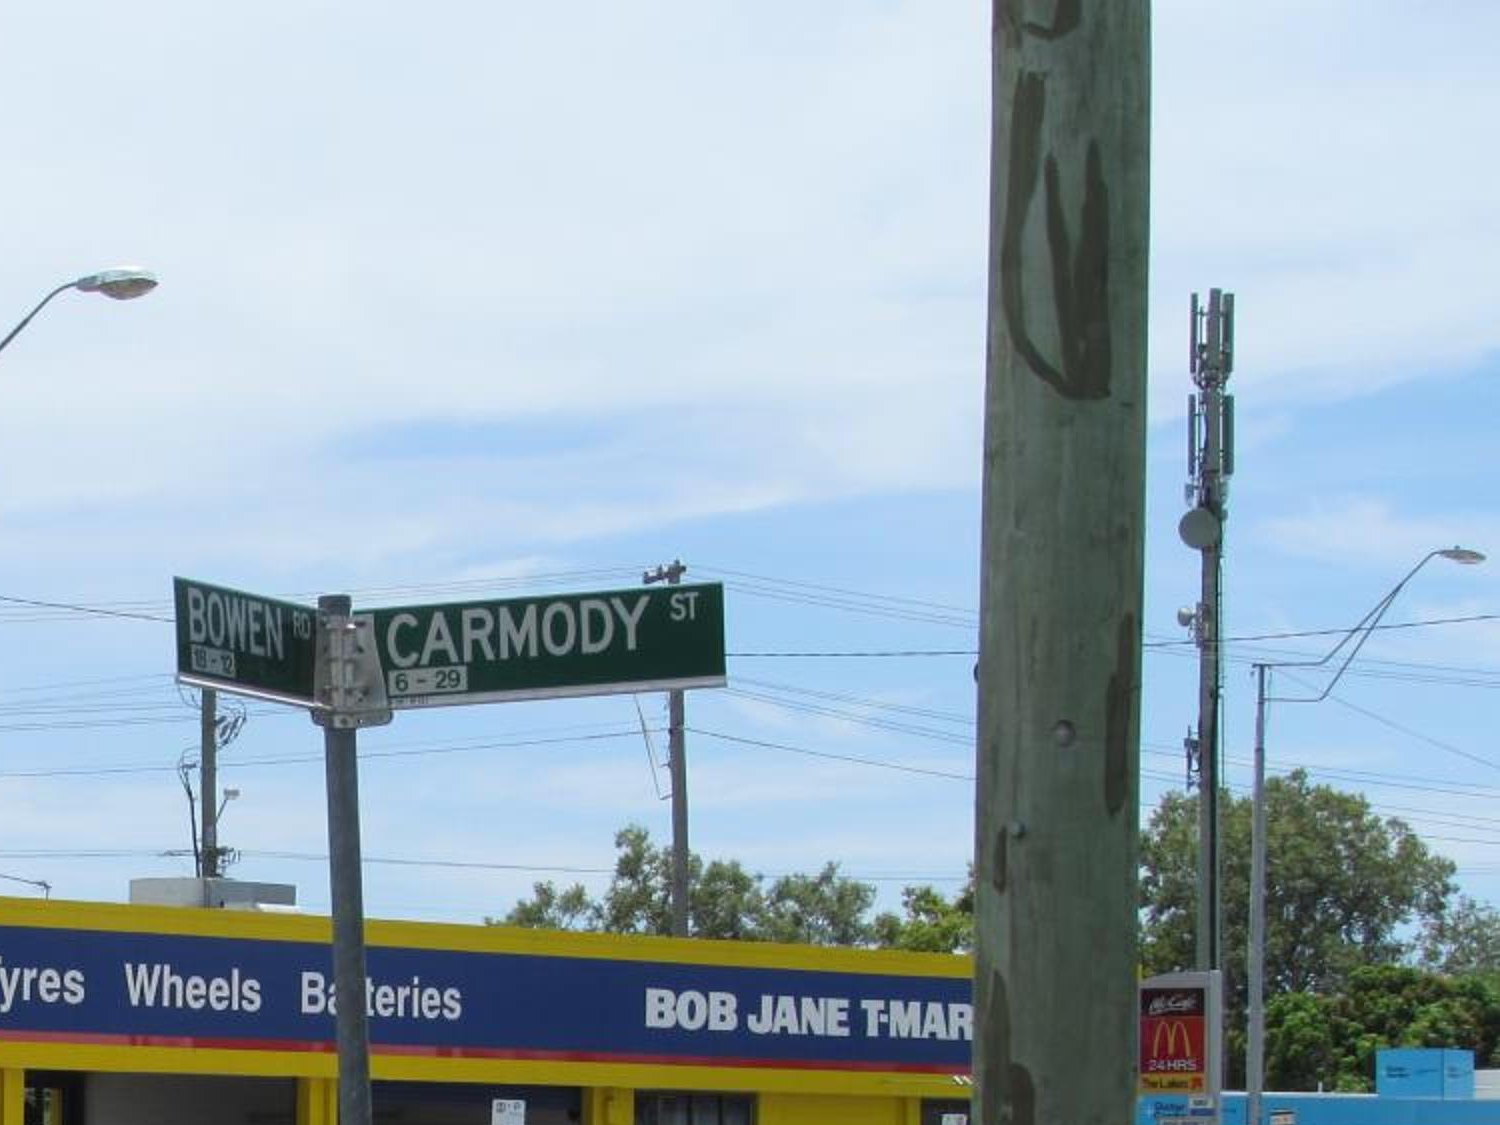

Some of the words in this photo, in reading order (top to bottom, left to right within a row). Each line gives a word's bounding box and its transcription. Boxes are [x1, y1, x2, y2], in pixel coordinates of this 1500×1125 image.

[187, 587, 284, 661] BOWEN
[293, 610, 311, 640] RD
[387, 596, 649, 667] CARMODY
[670, 592, 699, 620] ST
[395, 673, 409, 692] 6
[435, 669, 461, 690] 29
[124, 963, 261, 1012] Wheels
[301, 971, 462, 1020] Bteries
[645, 987, 739, 1031] BOB
[747, 995, 850, 1037] JANE
[861, 999, 974, 1040] T-MAR
[1148, 1059, 1165, 1071] 24
[1167, 1059, 1197, 1071] HRS
